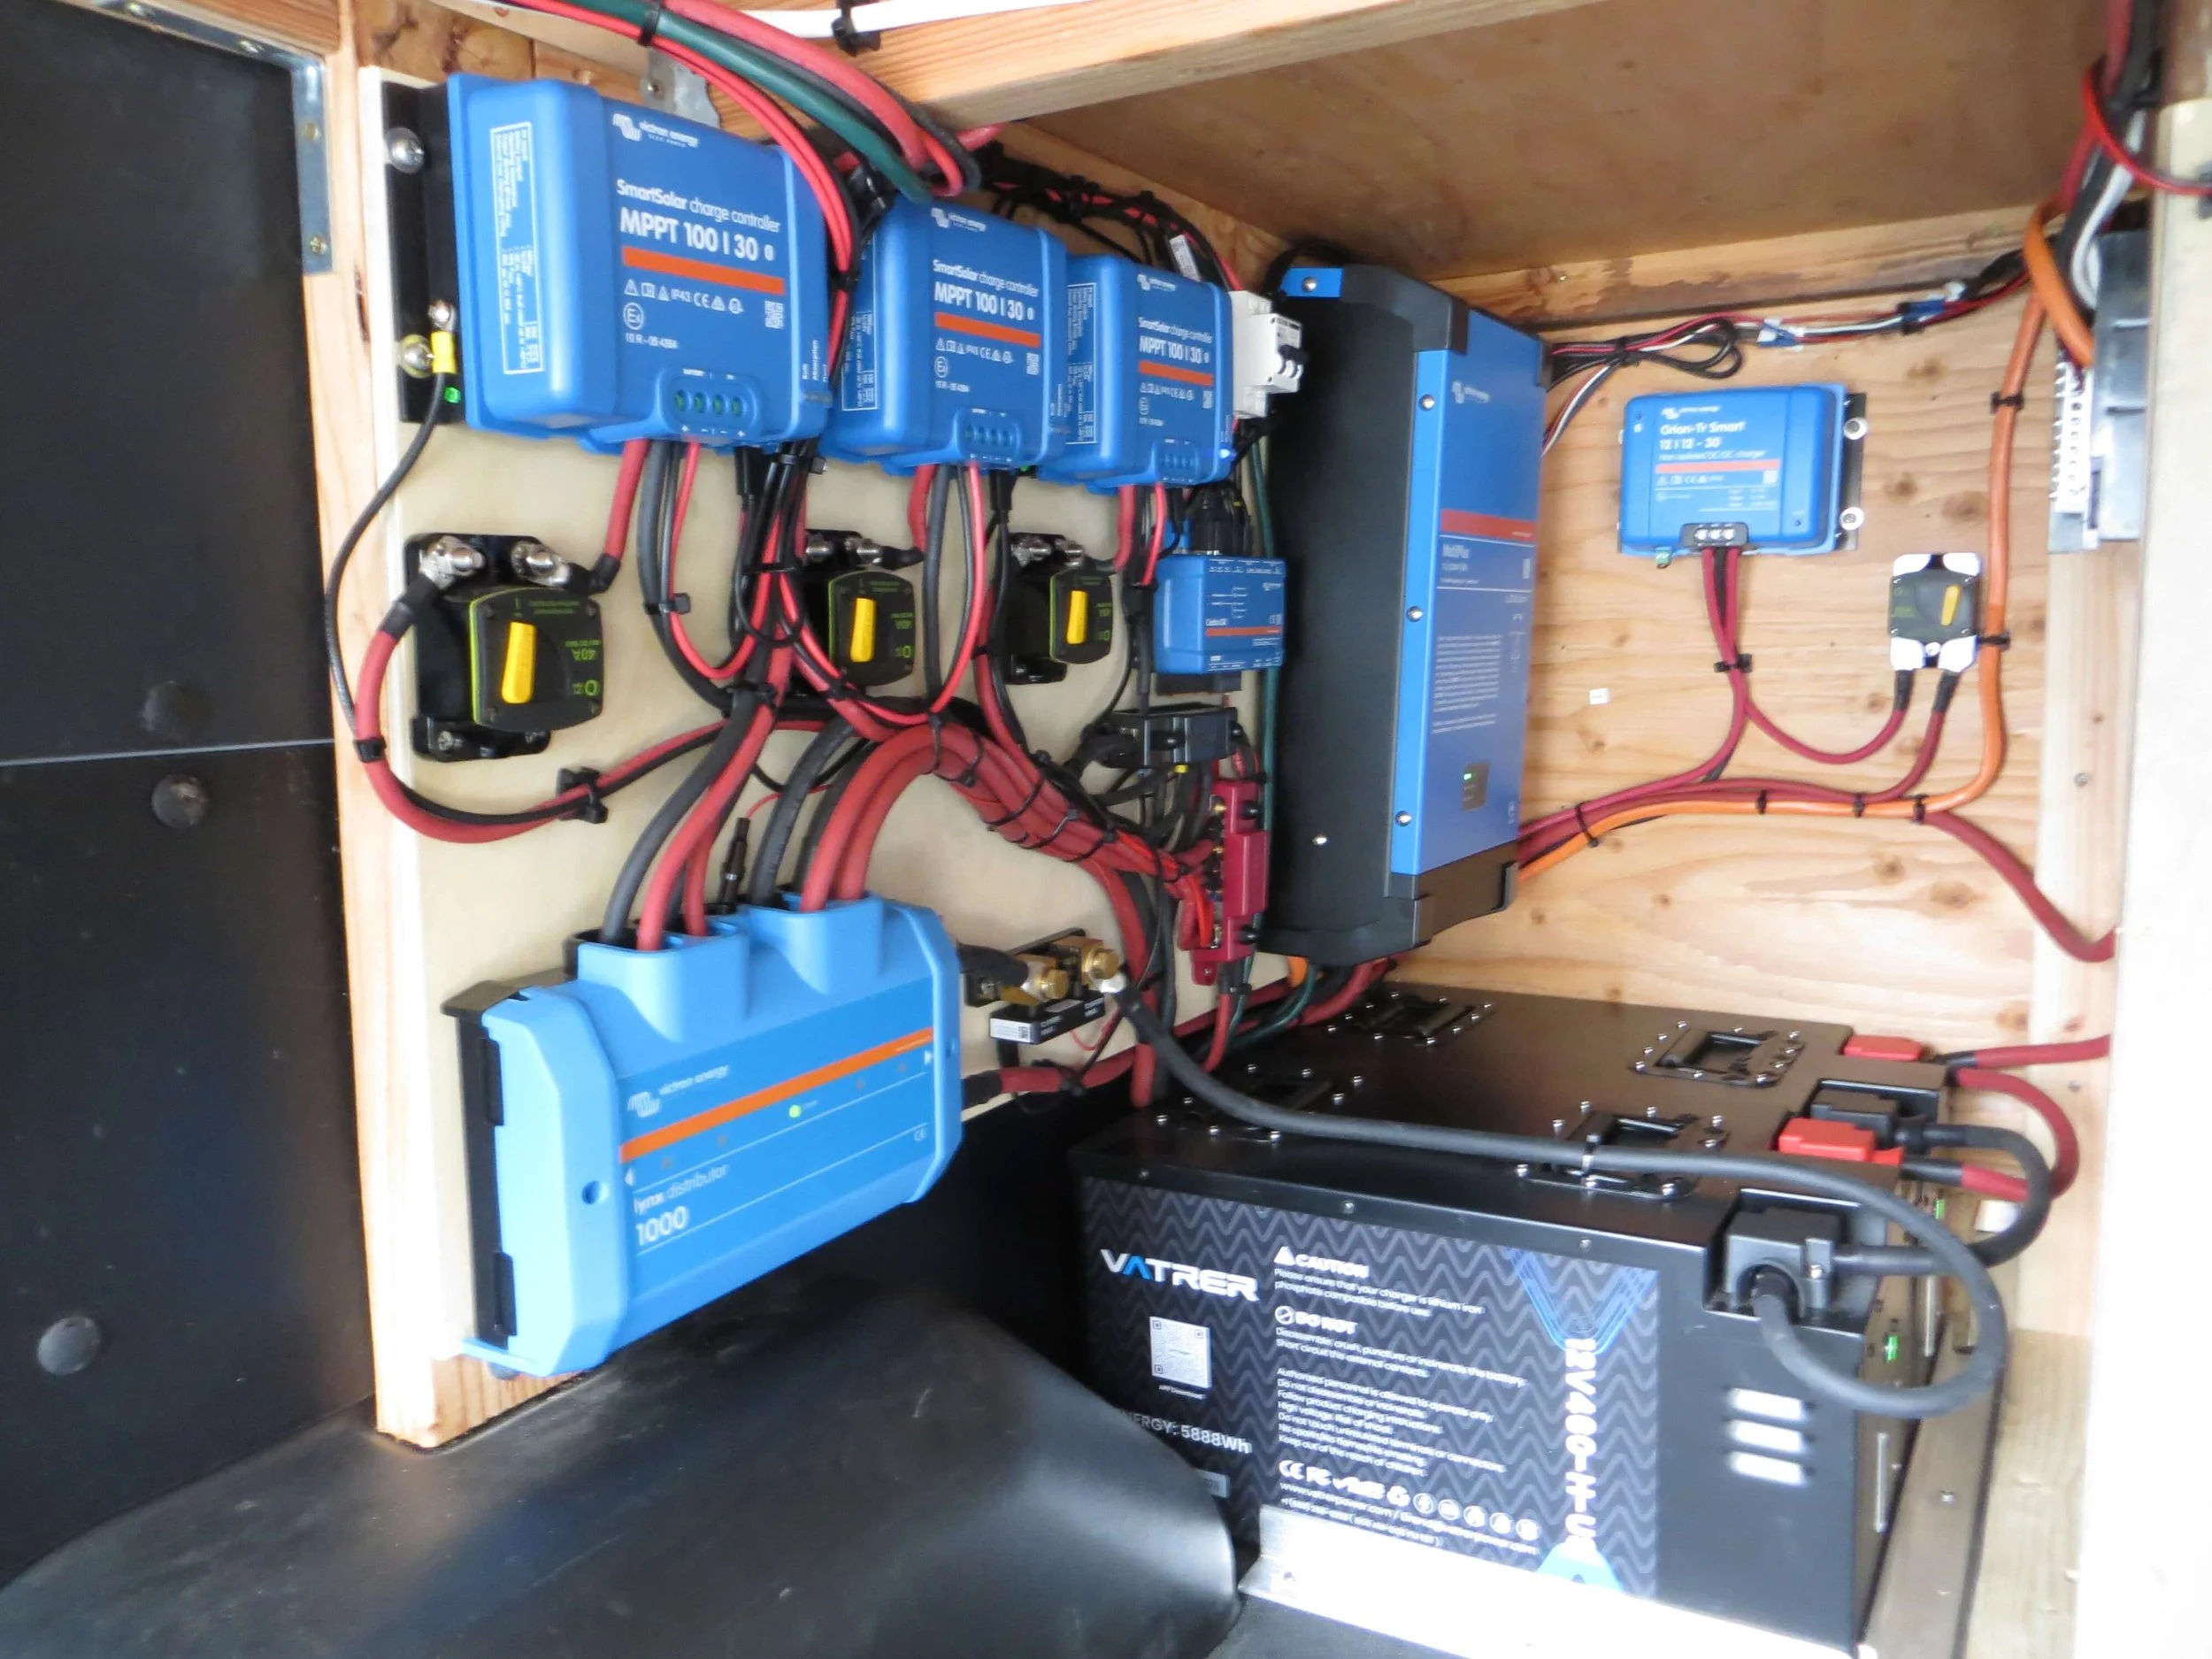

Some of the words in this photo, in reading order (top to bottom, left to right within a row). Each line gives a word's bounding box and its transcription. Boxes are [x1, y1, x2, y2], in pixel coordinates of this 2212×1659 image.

[616, 179, 687, 211] SmartSolar
[689, 196, 729, 223] charge
[731, 209, 780, 233] controller
[620, 206, 679, 244] MPPT
[682, 221, 718, 253] 100
[733, 234, 758, 262] 30
[933, 258, 978, 281] SmartSolar
[934, 281, 973, 309] MPPT
[975, 291, 998, 315] 100
[1007, 301, 1025, 321] 30
[1139, 335, 1166, 357] MPPT
[1168, 341, 1183, 361] 100
[1660, 422, 1708, 435] Orion-Tr
[1709, 420, 1747, 433] Smart
[634, 1189, 665, 1216] lynx
[666, 1164, 729, 1201] distributor
[635, 1205, 689, 1246] 1000
[1101, 1248, 1260, 1302] VATRER
[1295, 1253, 1370, 1279] CAUTION
[1274, 1268, 1304, 1281] Please
[1304, 1274, 1336, 1287] ensure
[1336, 1279, 1356, 1292] that
[1356, 1284, 1379, 1295] your
[1379, 1287, 1417, 1302] charger
[1417, 1294, 1427, 1304] is
[1427, 1296, 1461, 1311] lithium
[1461, 1302, 1484, 1315] iron
[1274, 1279, 1323, 1297] phosphate
[1324, 1290, 1378, 1307] compatible
[1377, 1298, 1410, 1314] before
[1294, 1310, 1321, 1327] DO
[1321, 1316, 1358, 1334] NOT
[1276, 1338, 1300, 1350] Short
[1300, 1343, 1329, 1357] circuit
[1329, 1349, 1346, 1361] the
[1363, 1345, 1405, 1363] puncture
[1405, 1354, 1417, 1363] or
[1467, 1365, 1485, 1378] the
[1291, 1381, 1307, 1392] not
[1371, 1388, 1379, 1398] is
[1379, 1390, 1417, 1405] allowed
[1417, 1398, 1429, 1407] to
[1277, 1389, 1306, 1402] Follow
[1306, 1397, 1342, 1412] product
[1342, 1405, 1386, 1423] charging
[1291, 1415, 1307, 1425] not
[1307, 1418, 1334, 1432] touch
[1353, 1417, 1363, 1427] of
[1180, 1424, 1253, 1454] 5888Wh
[1279, 1433, 1302, 1448] Keep
[1302, 1439, 1318, 1450] out
[1317, 1443, 1329, 1453] of
[1329, 1446, 1345, 1456] the
[1346, 1450, 1374, 1463] reach
